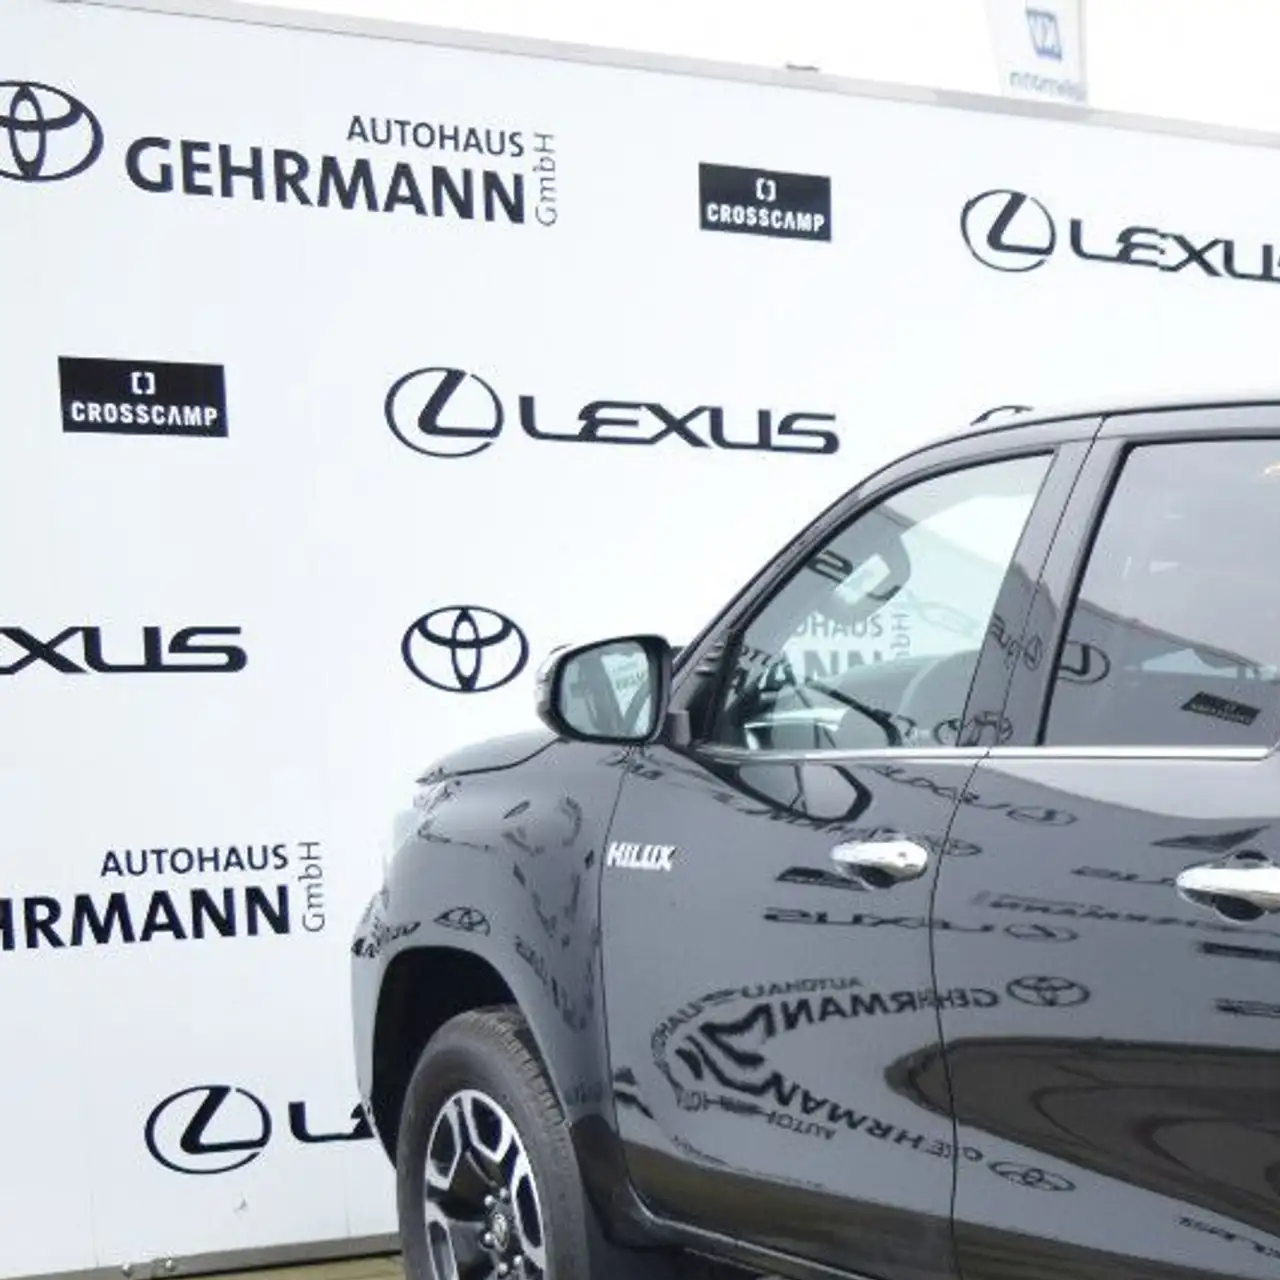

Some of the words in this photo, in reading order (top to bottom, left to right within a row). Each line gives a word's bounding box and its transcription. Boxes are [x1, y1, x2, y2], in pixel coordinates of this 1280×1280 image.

[346, 115, 525, 161] AUTOHAUS
[124, 136, 525, 225] GEHRMANN
[531, 132, 558, 228] GmbH
[703, 202, 825, 234] CROSSCAMP
[71, 400, 218, 427] CROSSCAMP
[518, 395, 840, 455] LEXUS
[100, 843, 289, 877] AUTOHAUS
[606, 840, 680, 873] HILUX
[297, 841, 326, 933] GmbH
